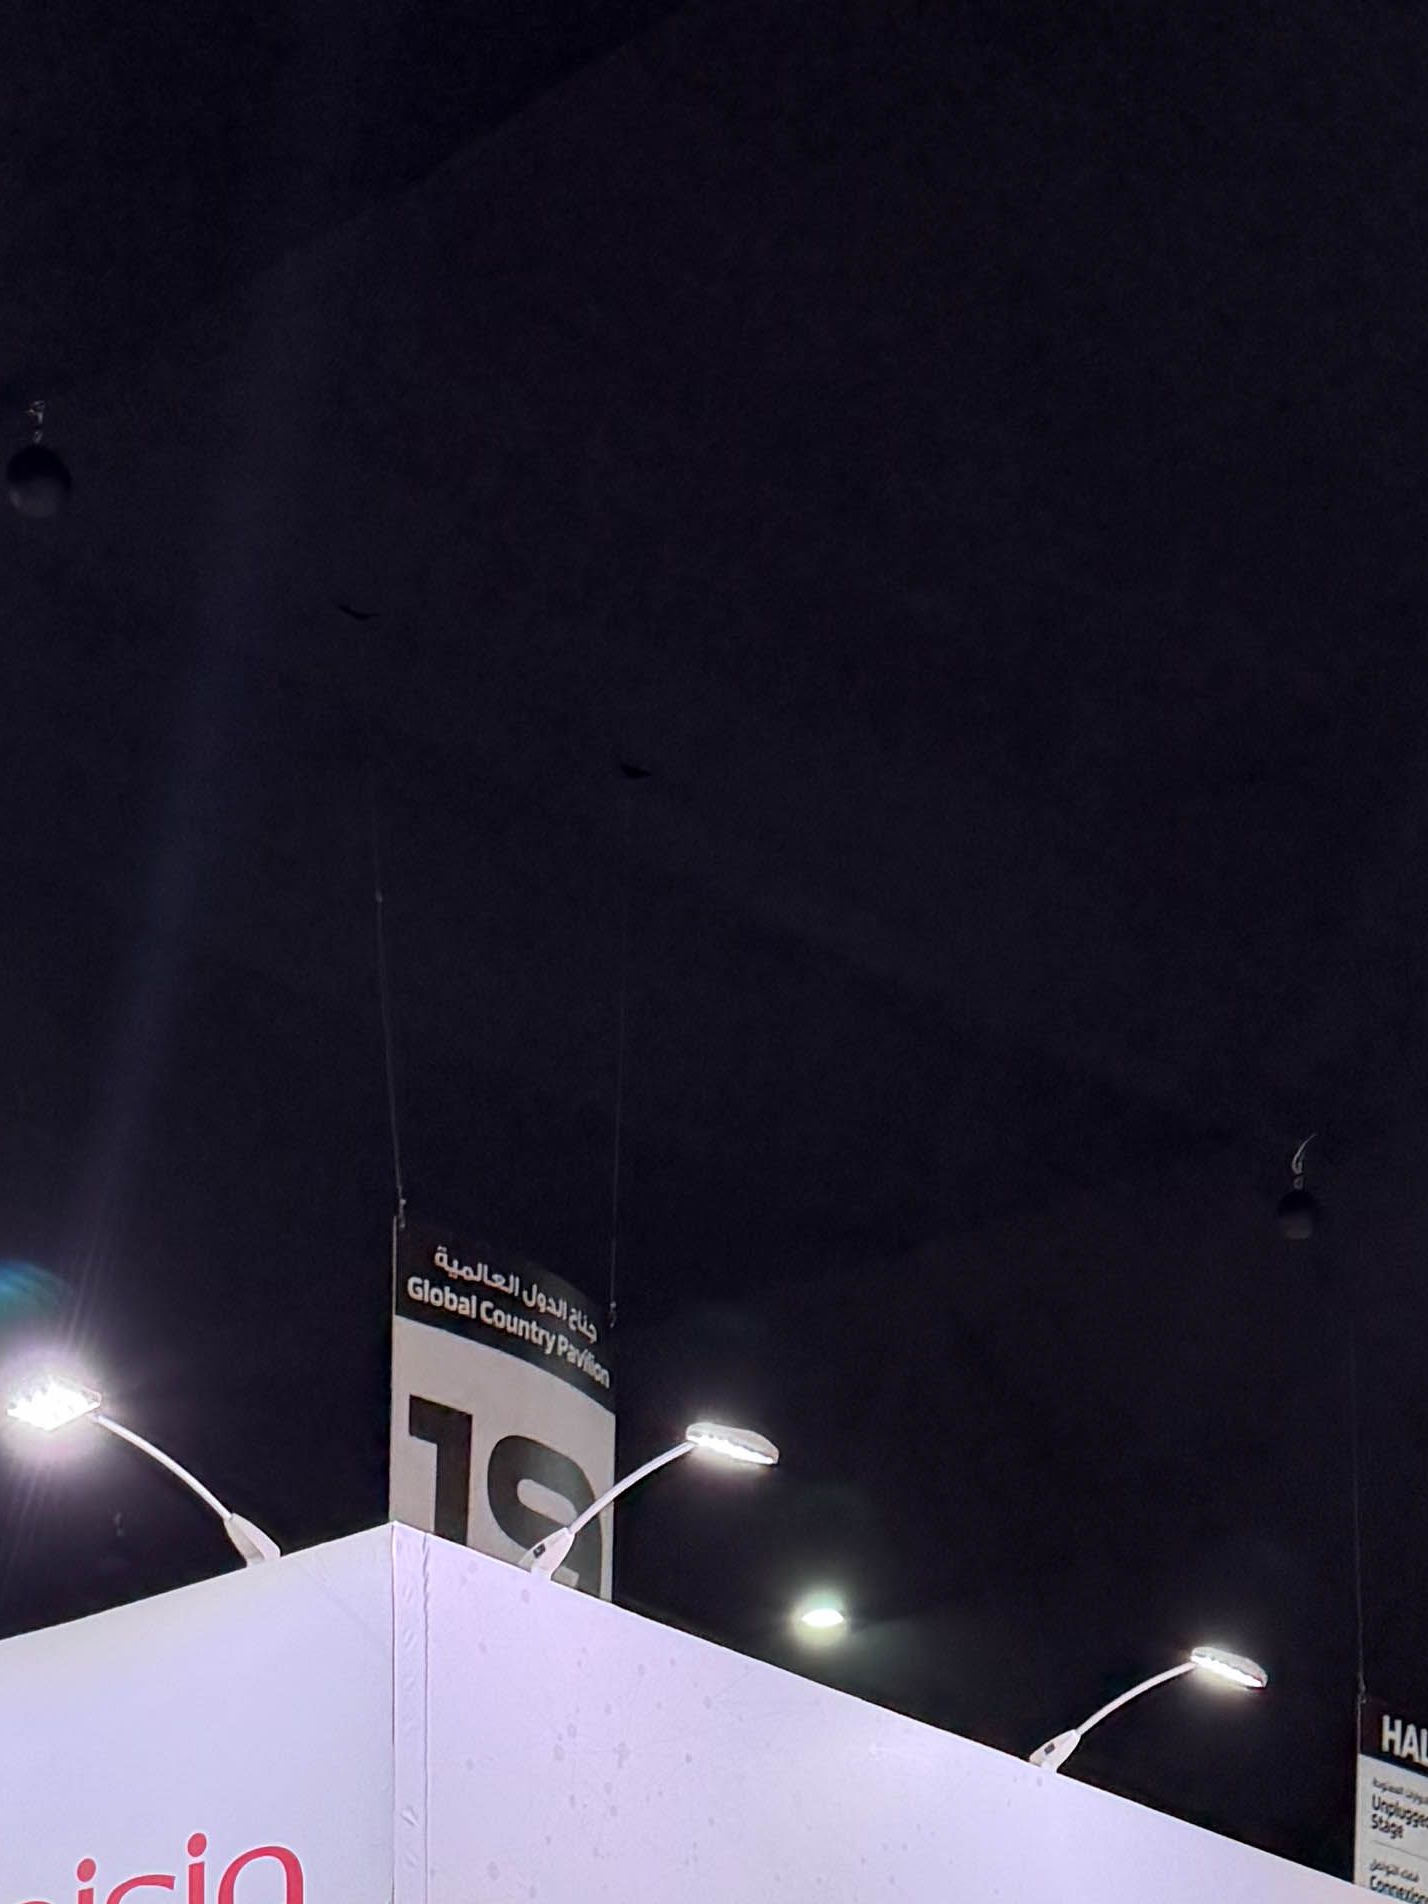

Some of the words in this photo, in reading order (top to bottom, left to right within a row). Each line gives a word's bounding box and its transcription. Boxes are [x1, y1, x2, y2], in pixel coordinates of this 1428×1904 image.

[434, 1245, 520, 1296] العالمية
[523, 1284, 567, 1321] الدول
[407, 1276, 477, 1319] Global
[480, 1301, 556, 1355] Country
[558, 1334, 610, 1389] Pavilion
[1371, 1813, 1404, 1839] Stage
